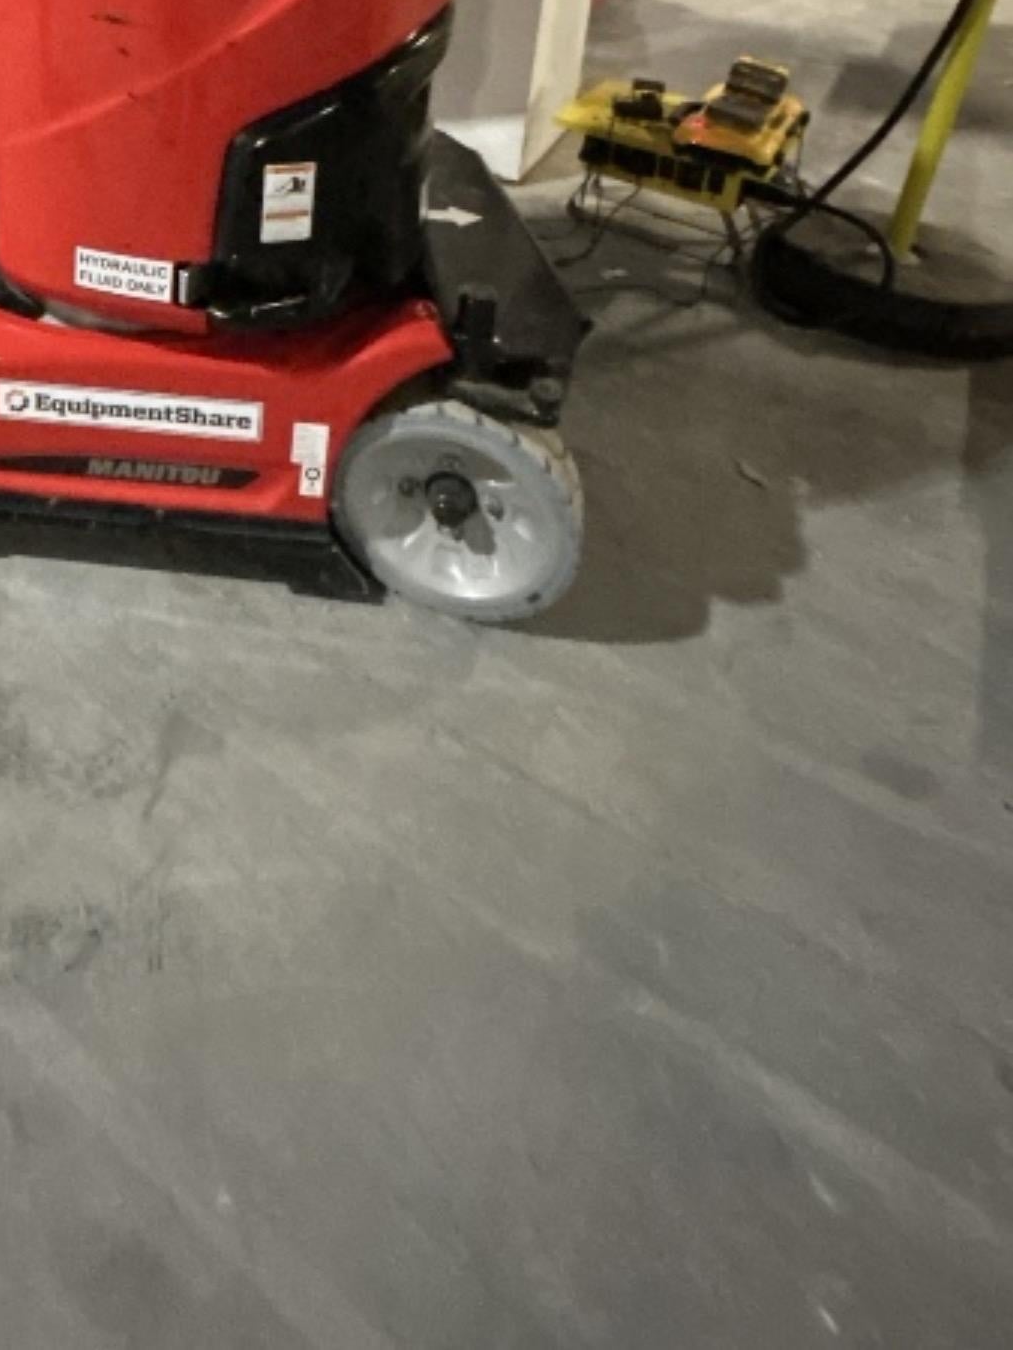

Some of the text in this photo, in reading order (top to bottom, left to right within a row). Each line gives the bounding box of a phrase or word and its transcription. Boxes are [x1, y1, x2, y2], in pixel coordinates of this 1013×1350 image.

[79, 252, 168, 280] HYDRAULIC
[78, 269, 168, 296] FLUID ONLY
[33, 393, 253, 431] EquipmentShare
[86, 458, 223, 486] MANITOU
